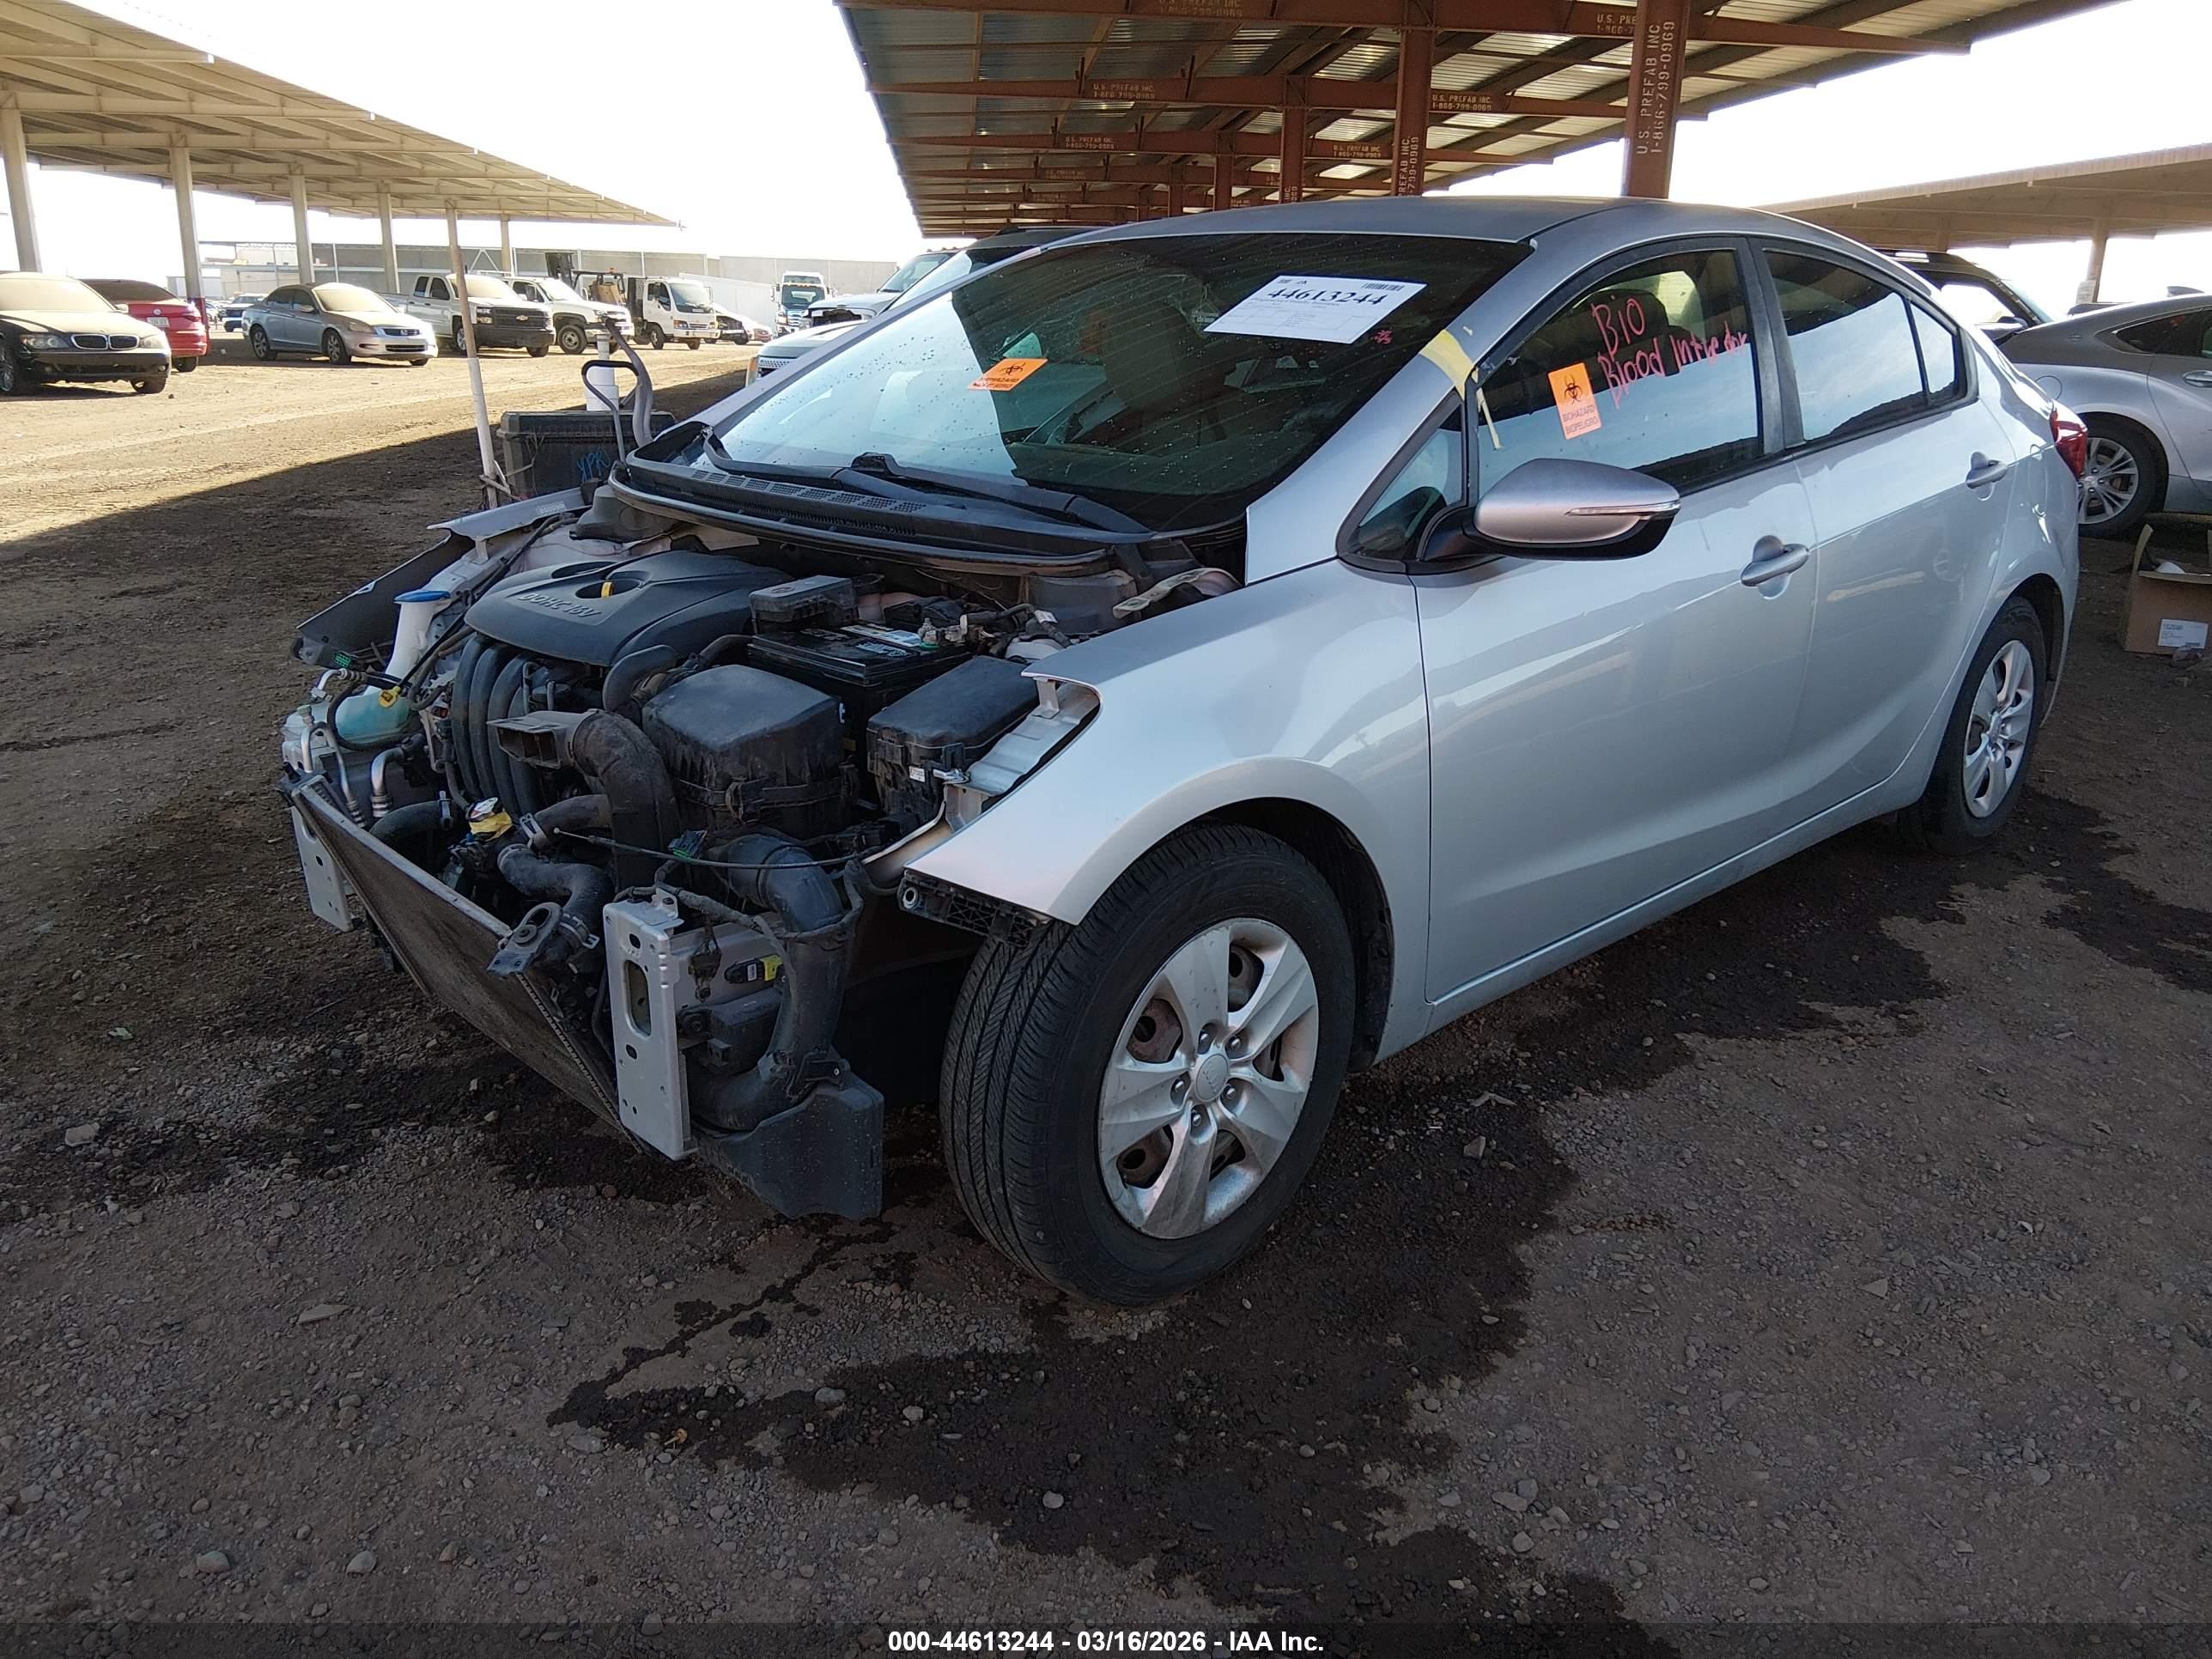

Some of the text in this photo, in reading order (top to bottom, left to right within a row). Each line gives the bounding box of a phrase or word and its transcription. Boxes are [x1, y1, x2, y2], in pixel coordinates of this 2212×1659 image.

[1597, 14, 1615, 23] U.S.
[1449, 94, 1477, 103] PREFAB
[1640, 58, 1657, 117] PREFAB
[1650, 21, 1675, 153] 1-866-799-0969
[1267, 288, 1388, 305] 44613244
[1597, 337, 1666, 410] Blood
[517, 592, 603, 617] DOHC 16V
